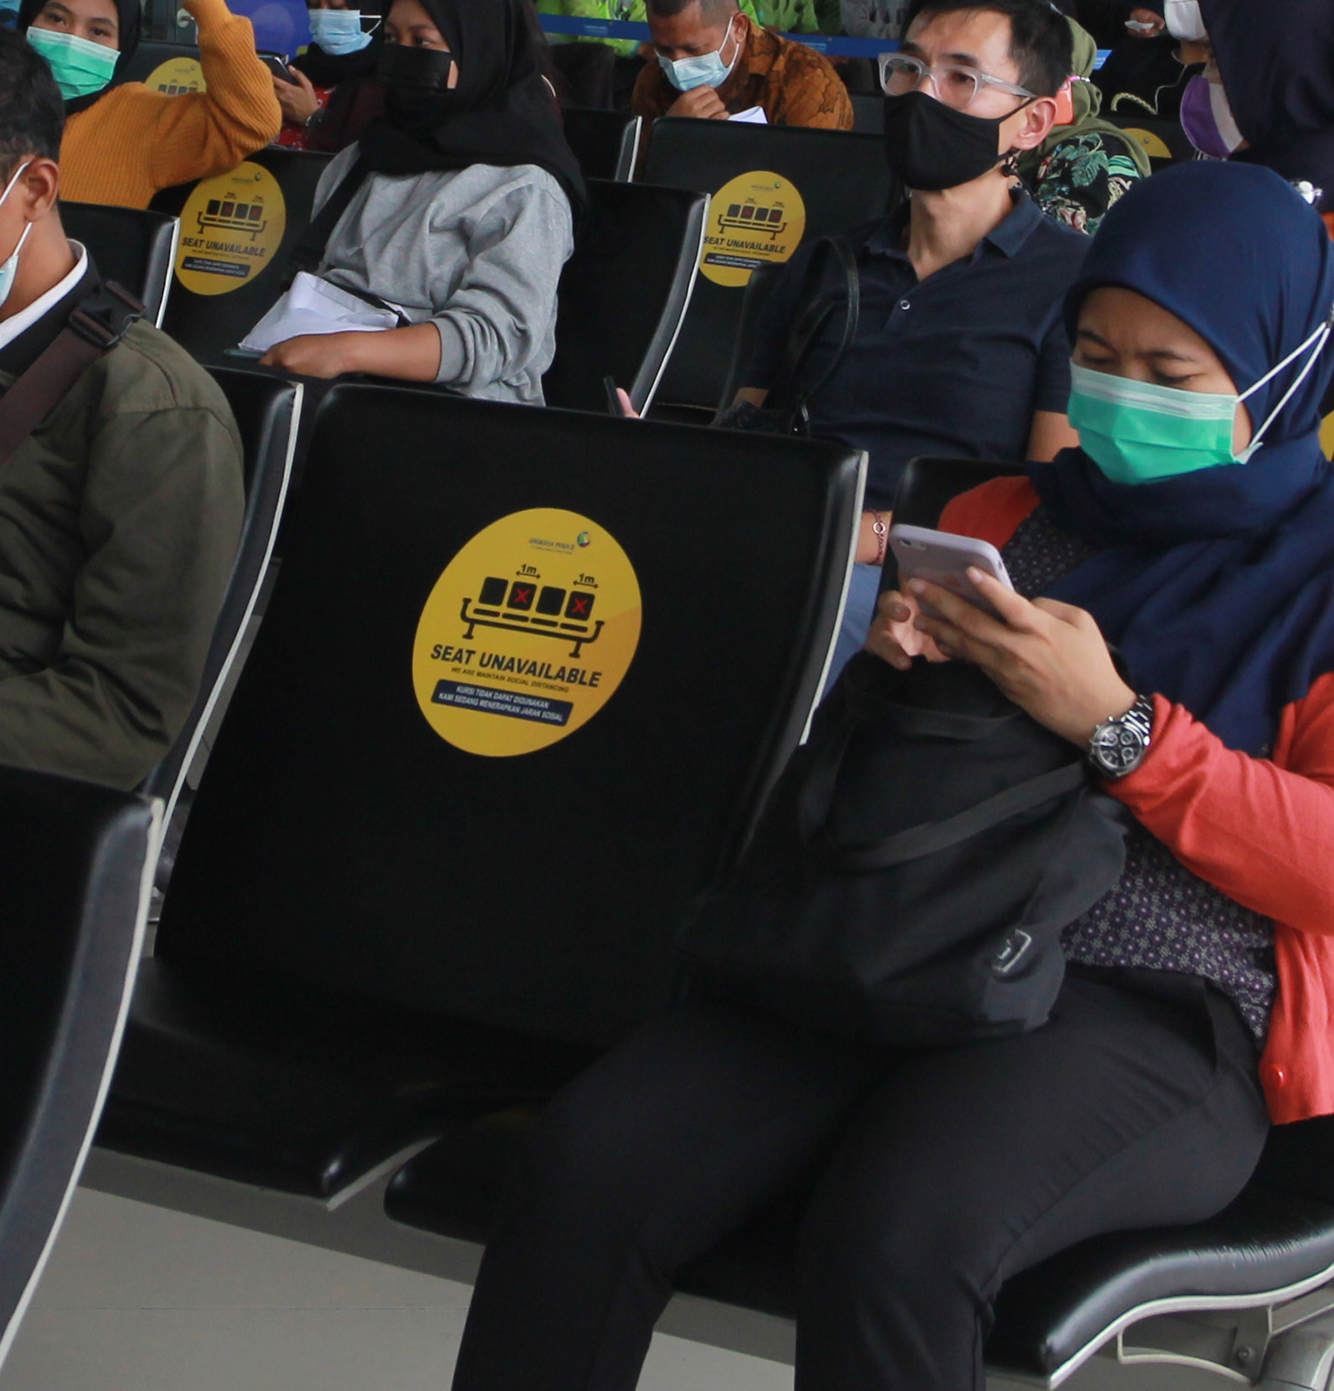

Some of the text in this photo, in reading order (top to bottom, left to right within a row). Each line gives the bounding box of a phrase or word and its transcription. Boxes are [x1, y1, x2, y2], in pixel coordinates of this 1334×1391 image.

[182, 237, 205, 248] SEAT
[206, 240, 267, 257] UNAVAILABLE
[703, 235, 726, 245] SEAT
[727, 239, 787, 254] UNAVAILABLE
[521, 563, 537, 575] 1m
[579, 573, 596, 585] 1m
[430, 644, 602, 688] SEAT UNAVAILABLE
